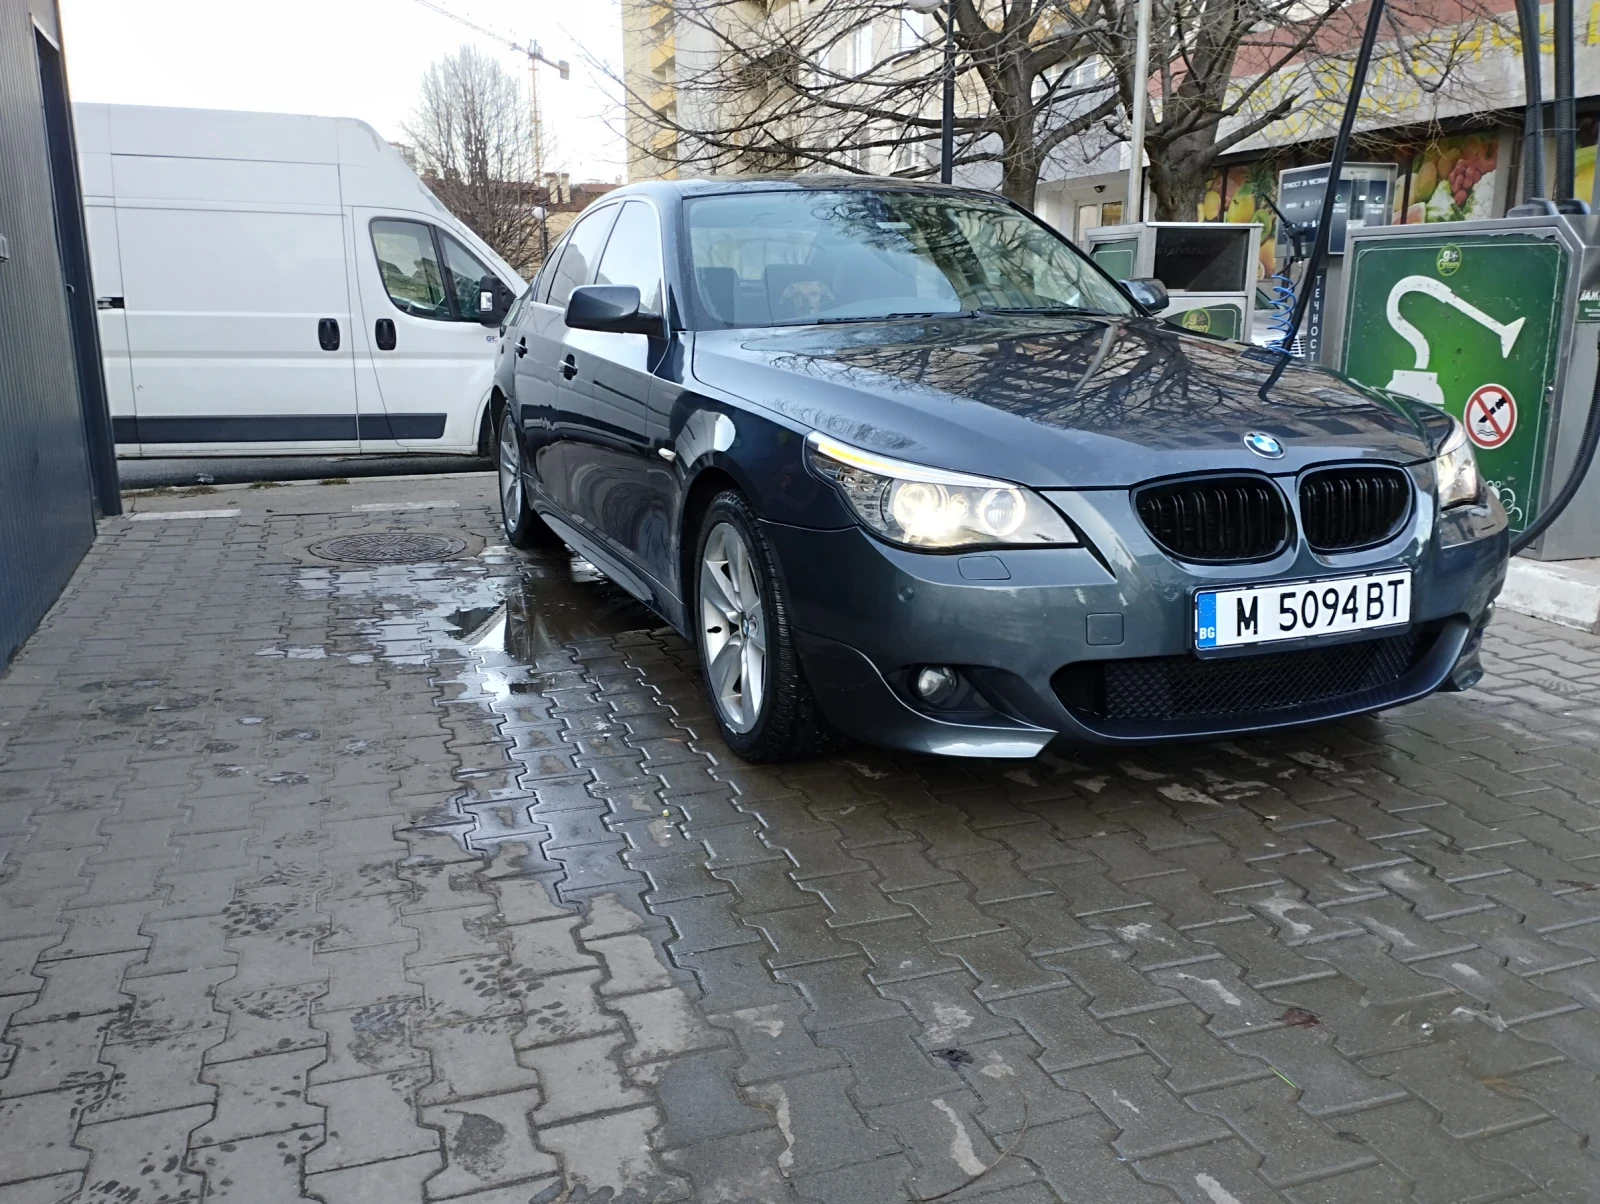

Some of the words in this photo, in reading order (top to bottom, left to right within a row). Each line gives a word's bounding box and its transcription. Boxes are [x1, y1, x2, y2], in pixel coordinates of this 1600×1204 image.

[1310, 275, 1322, 362] ТЕЧНОСТ
[1199, 626, 1216, 640] BG
[1236, 595, 1259, 637] M
